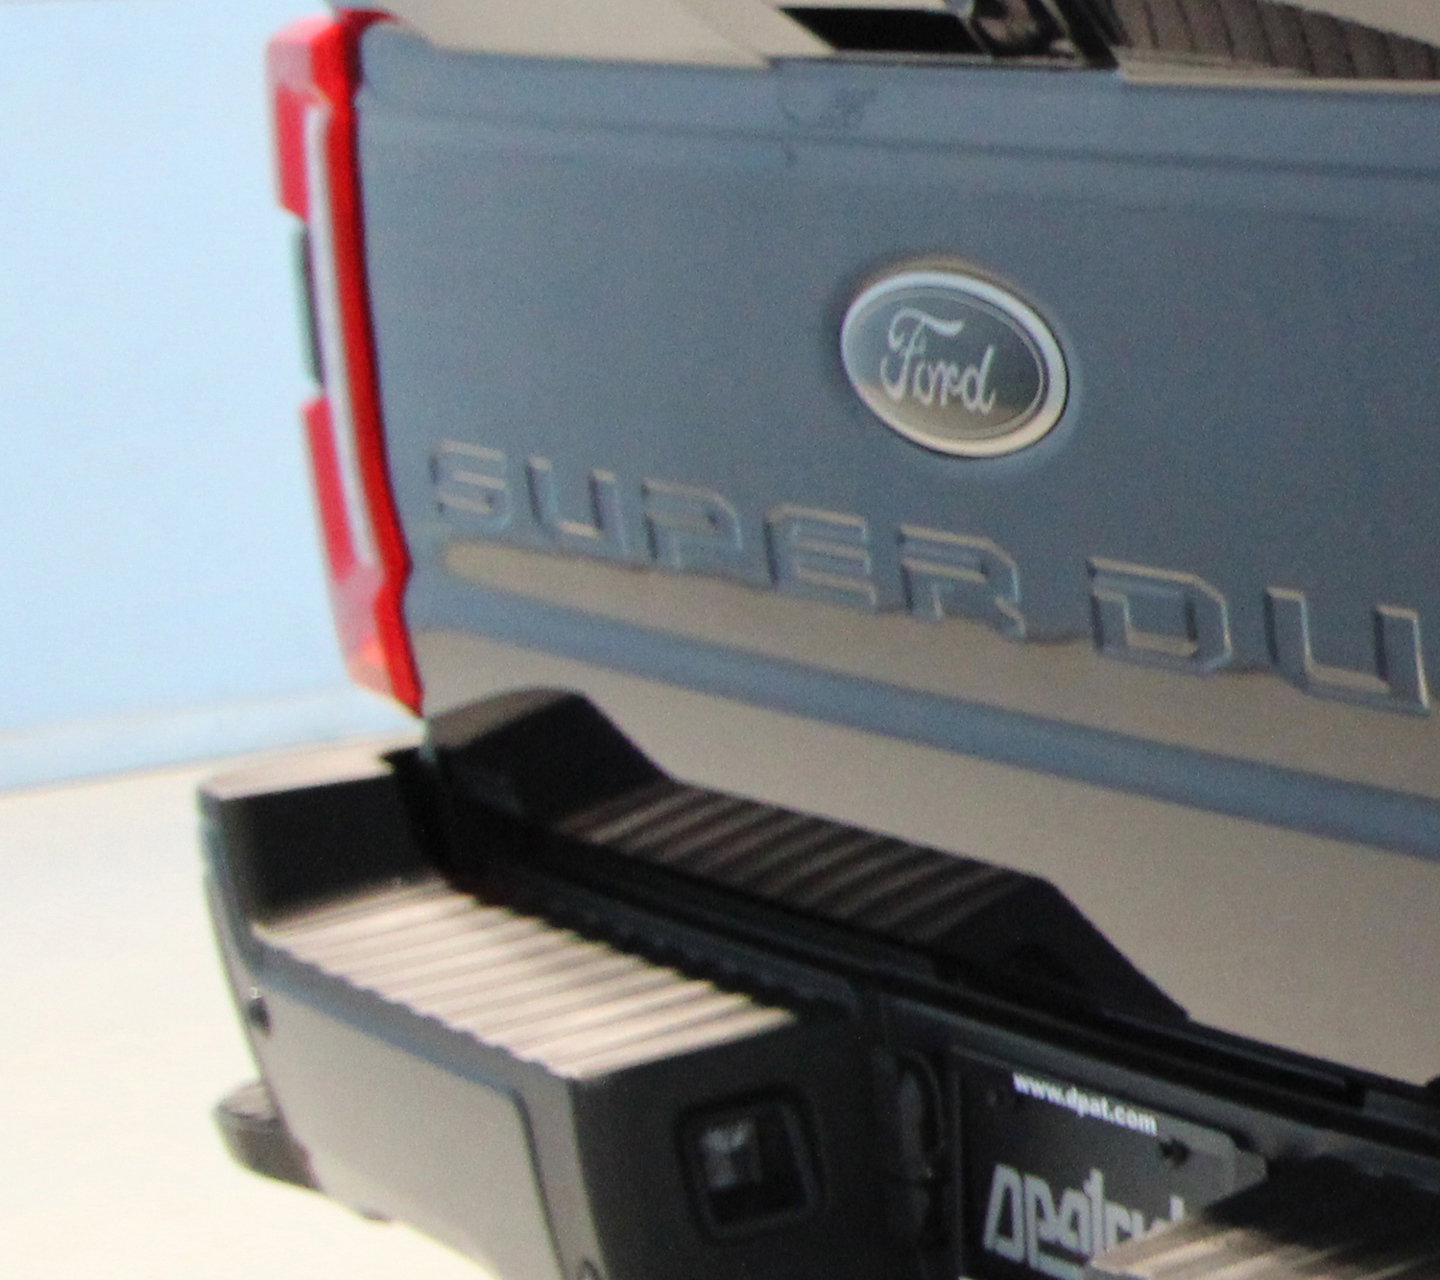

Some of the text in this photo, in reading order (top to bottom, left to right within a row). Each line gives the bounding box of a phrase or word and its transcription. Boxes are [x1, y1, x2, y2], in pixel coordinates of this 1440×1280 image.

[880, 305, 997, 417] Ford
[430, 438, 1027, 644] SUPER
[1011, 1073, 1158, 1136] www.dpat.com
